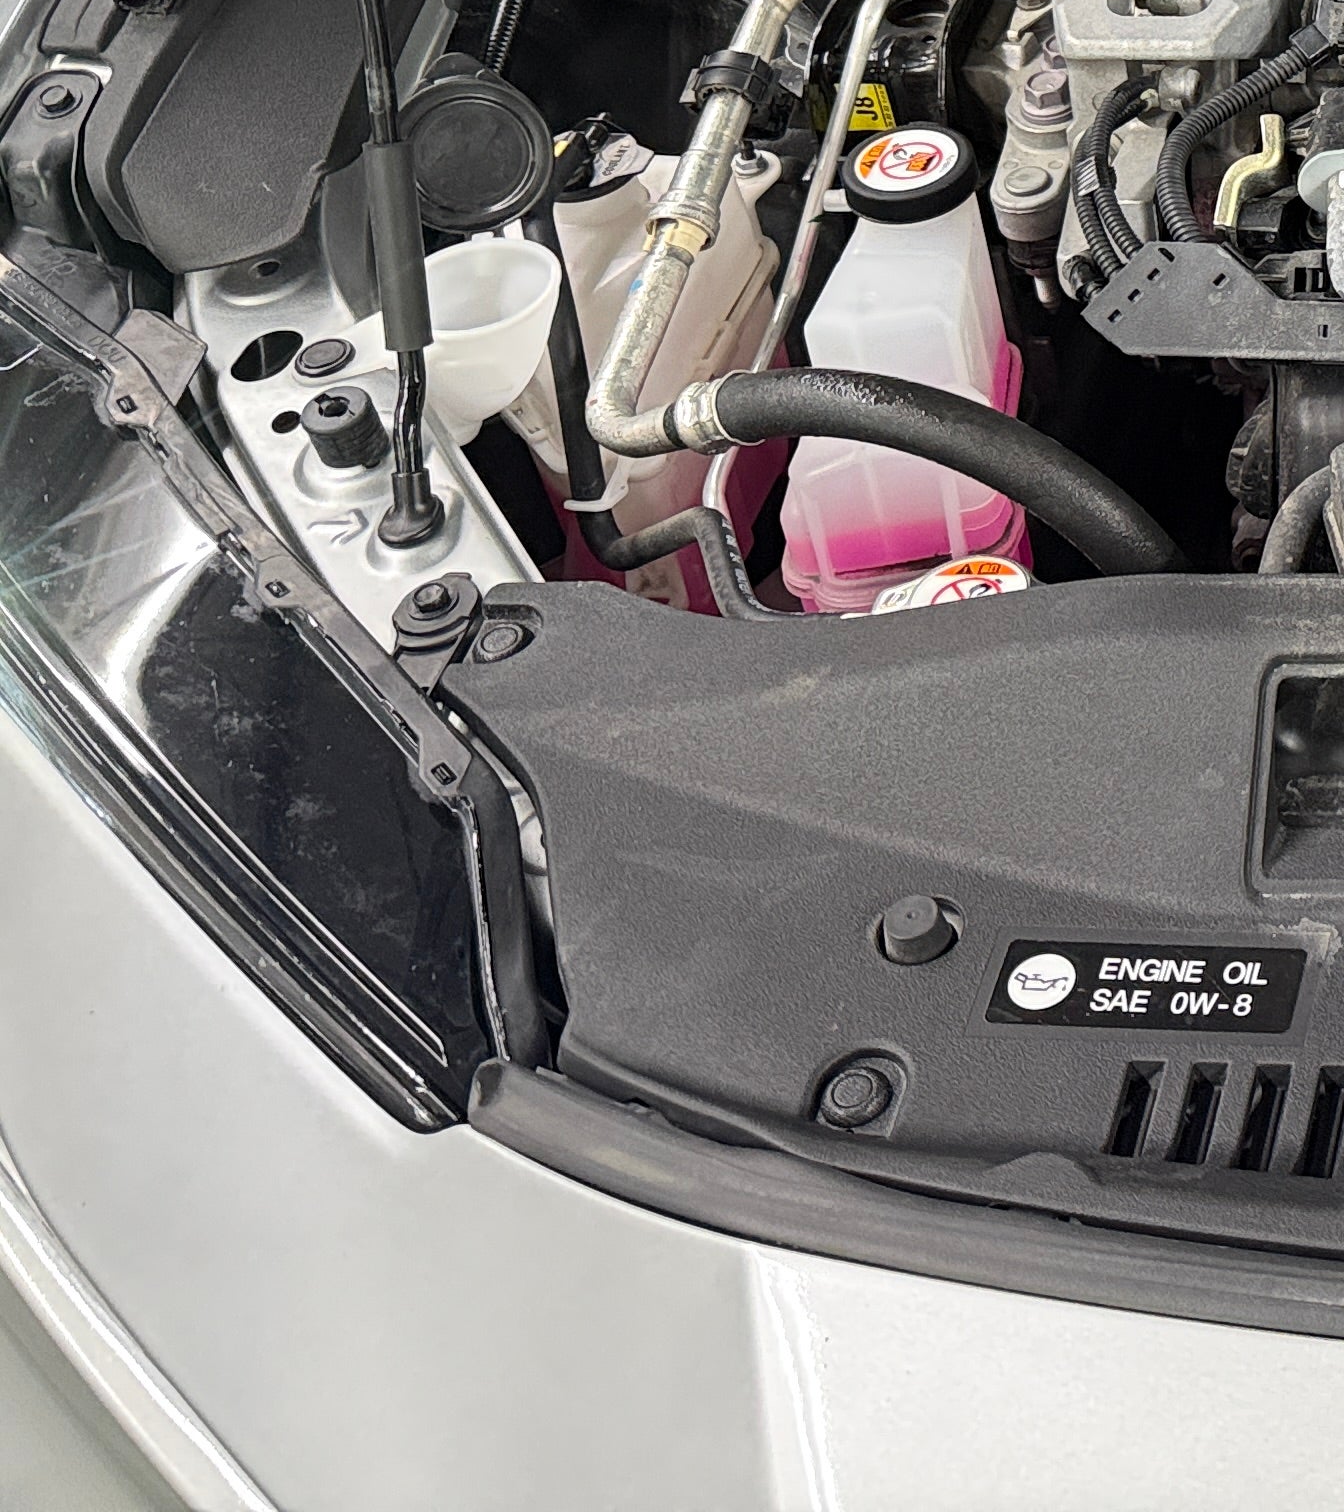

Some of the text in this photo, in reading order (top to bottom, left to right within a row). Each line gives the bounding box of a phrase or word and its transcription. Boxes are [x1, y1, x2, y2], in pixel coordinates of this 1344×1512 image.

[1098, 957, 1268, 986] ENGINE OIL
[1090, 988, 1253, 1017] SAE 0W-8
